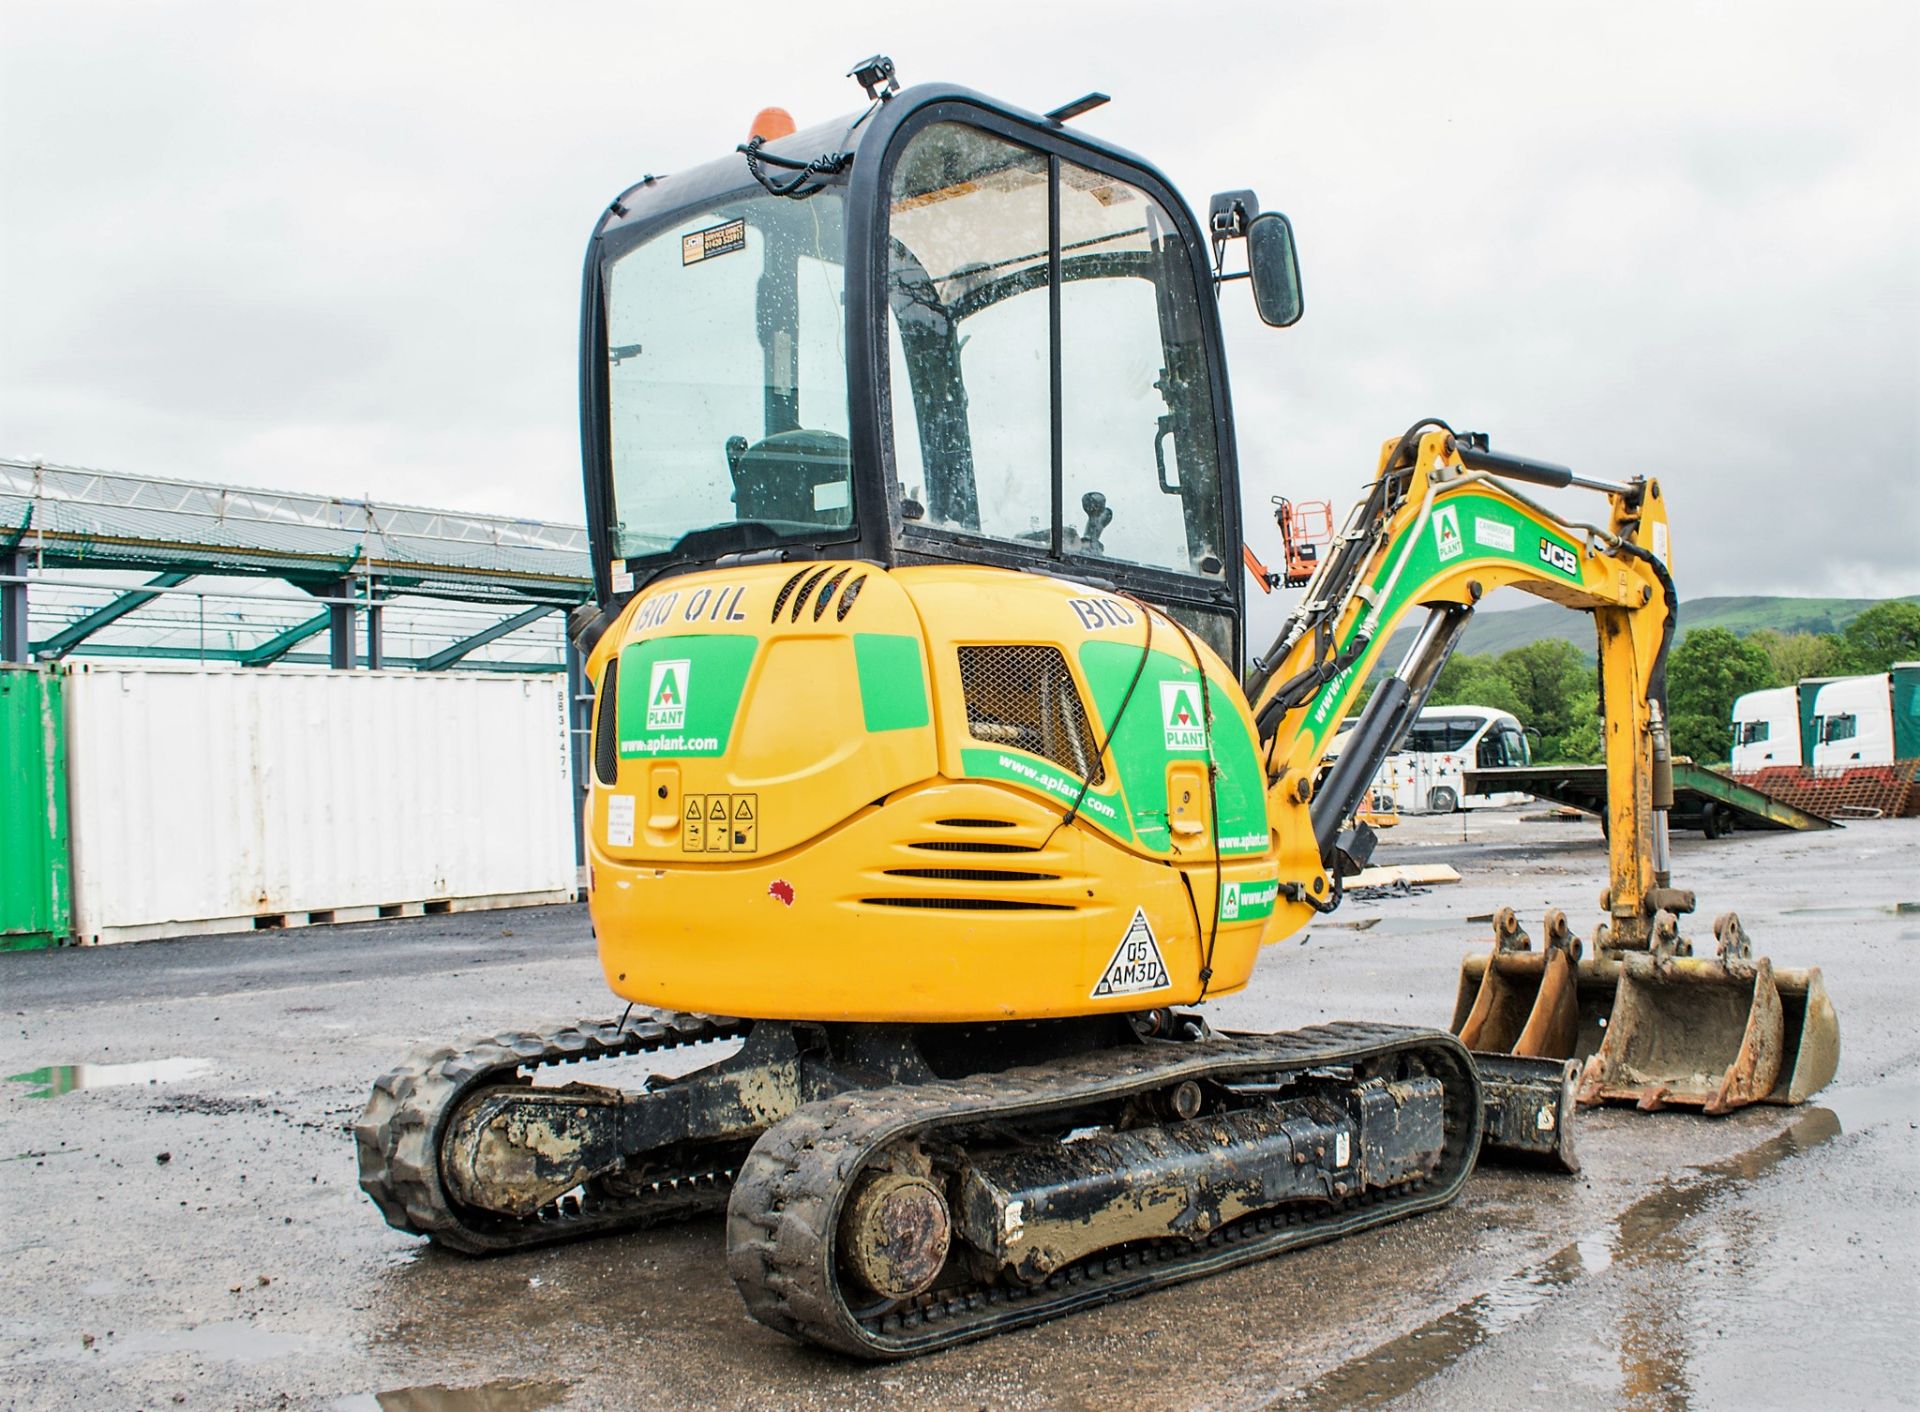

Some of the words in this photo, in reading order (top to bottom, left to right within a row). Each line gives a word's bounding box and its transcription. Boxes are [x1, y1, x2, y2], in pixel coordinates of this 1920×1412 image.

[1439, 541, 1461, 556] PLANT
[1540, 538, 1577, 575] JCB
[634, 592, 679, 632] BIO
[684, 586, 745, 621] OIL
[1068, 598, 1135, 630] BIO
[652, 668, 682, 706] A
[648, 710, 684, 725] PLANT
[1169, 689, 1201, 727] A
[620, 734, 718, 756] www.aplant.com
[1166, 732, 1204, 746] PLANT
